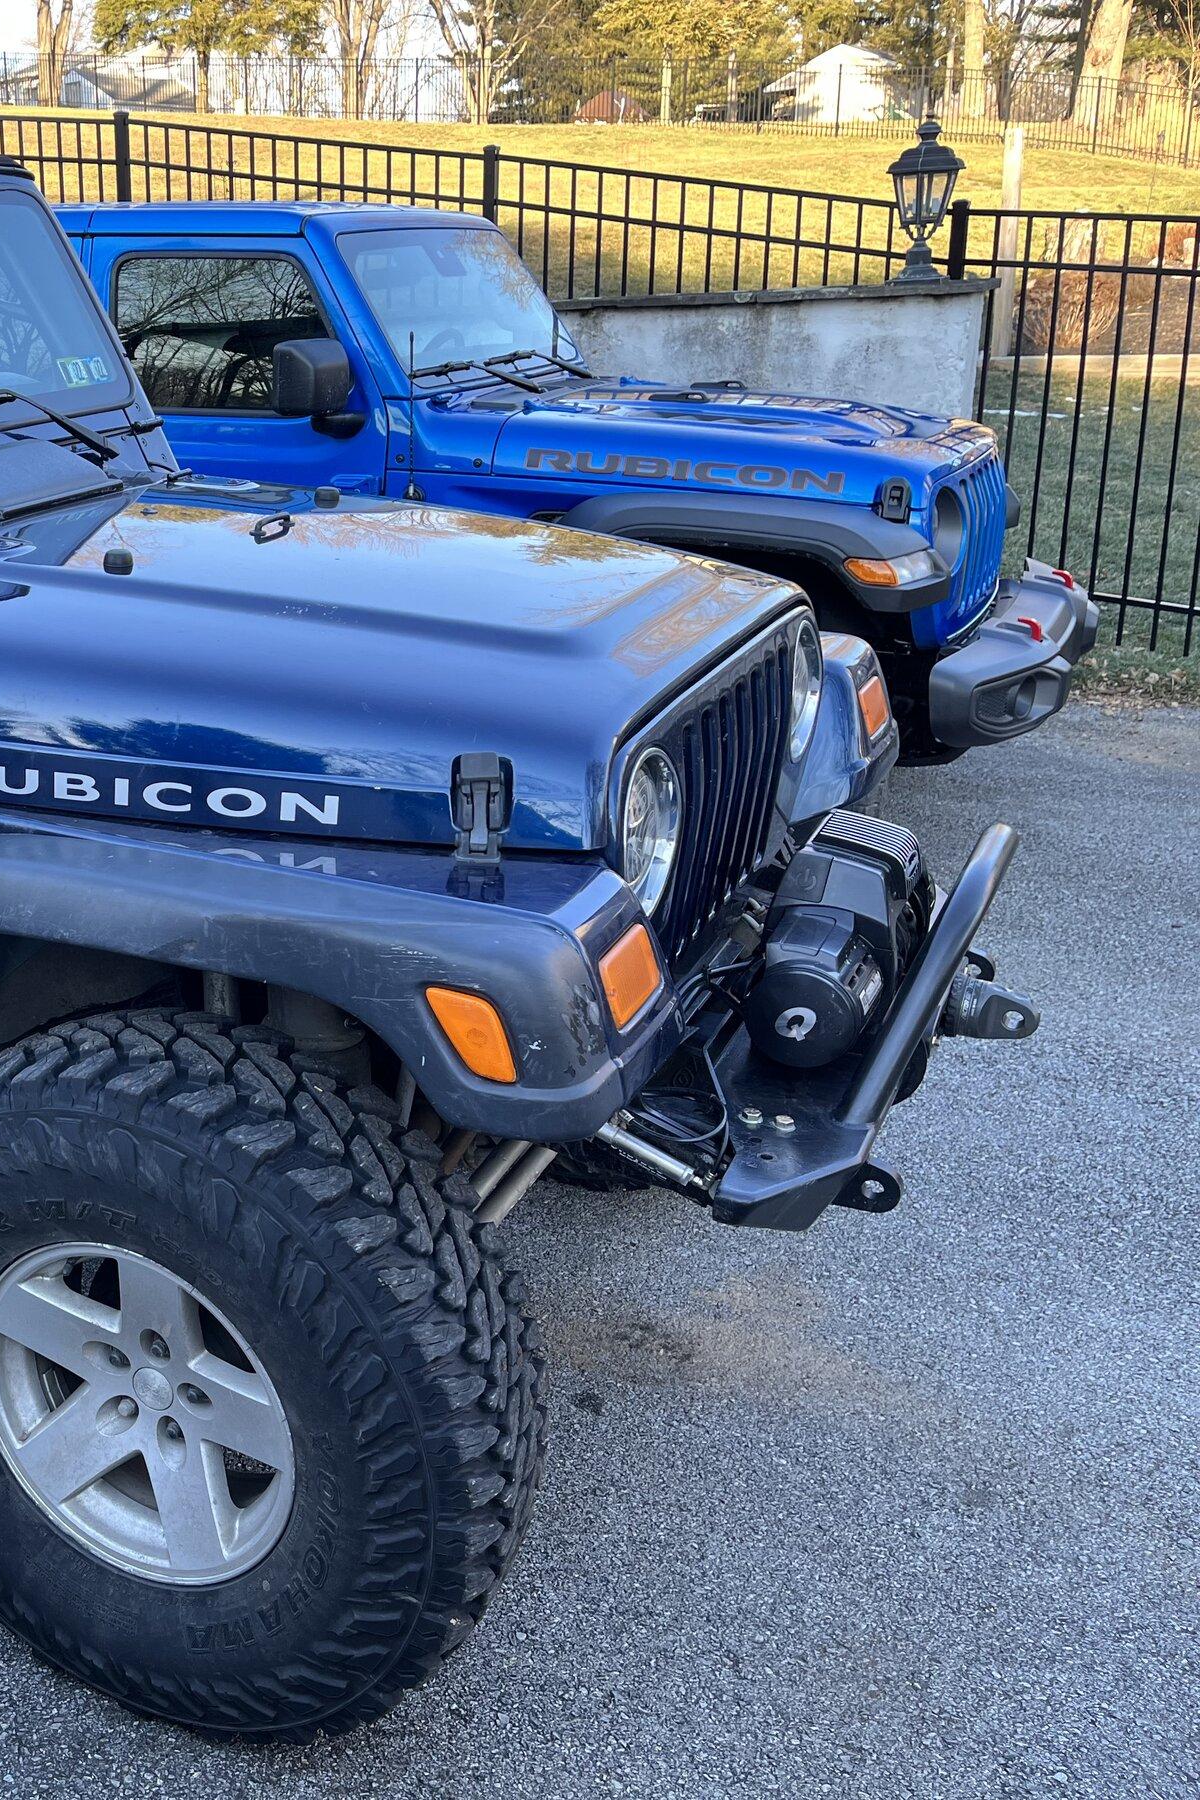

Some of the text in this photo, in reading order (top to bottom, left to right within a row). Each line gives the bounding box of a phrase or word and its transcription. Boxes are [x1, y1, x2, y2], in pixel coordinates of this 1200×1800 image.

[524, 448, 846, 494] RUBICON
[22, 1196, 138, 1230] M/T
[184, 1431, 343, 1654] YOKOHAMA
